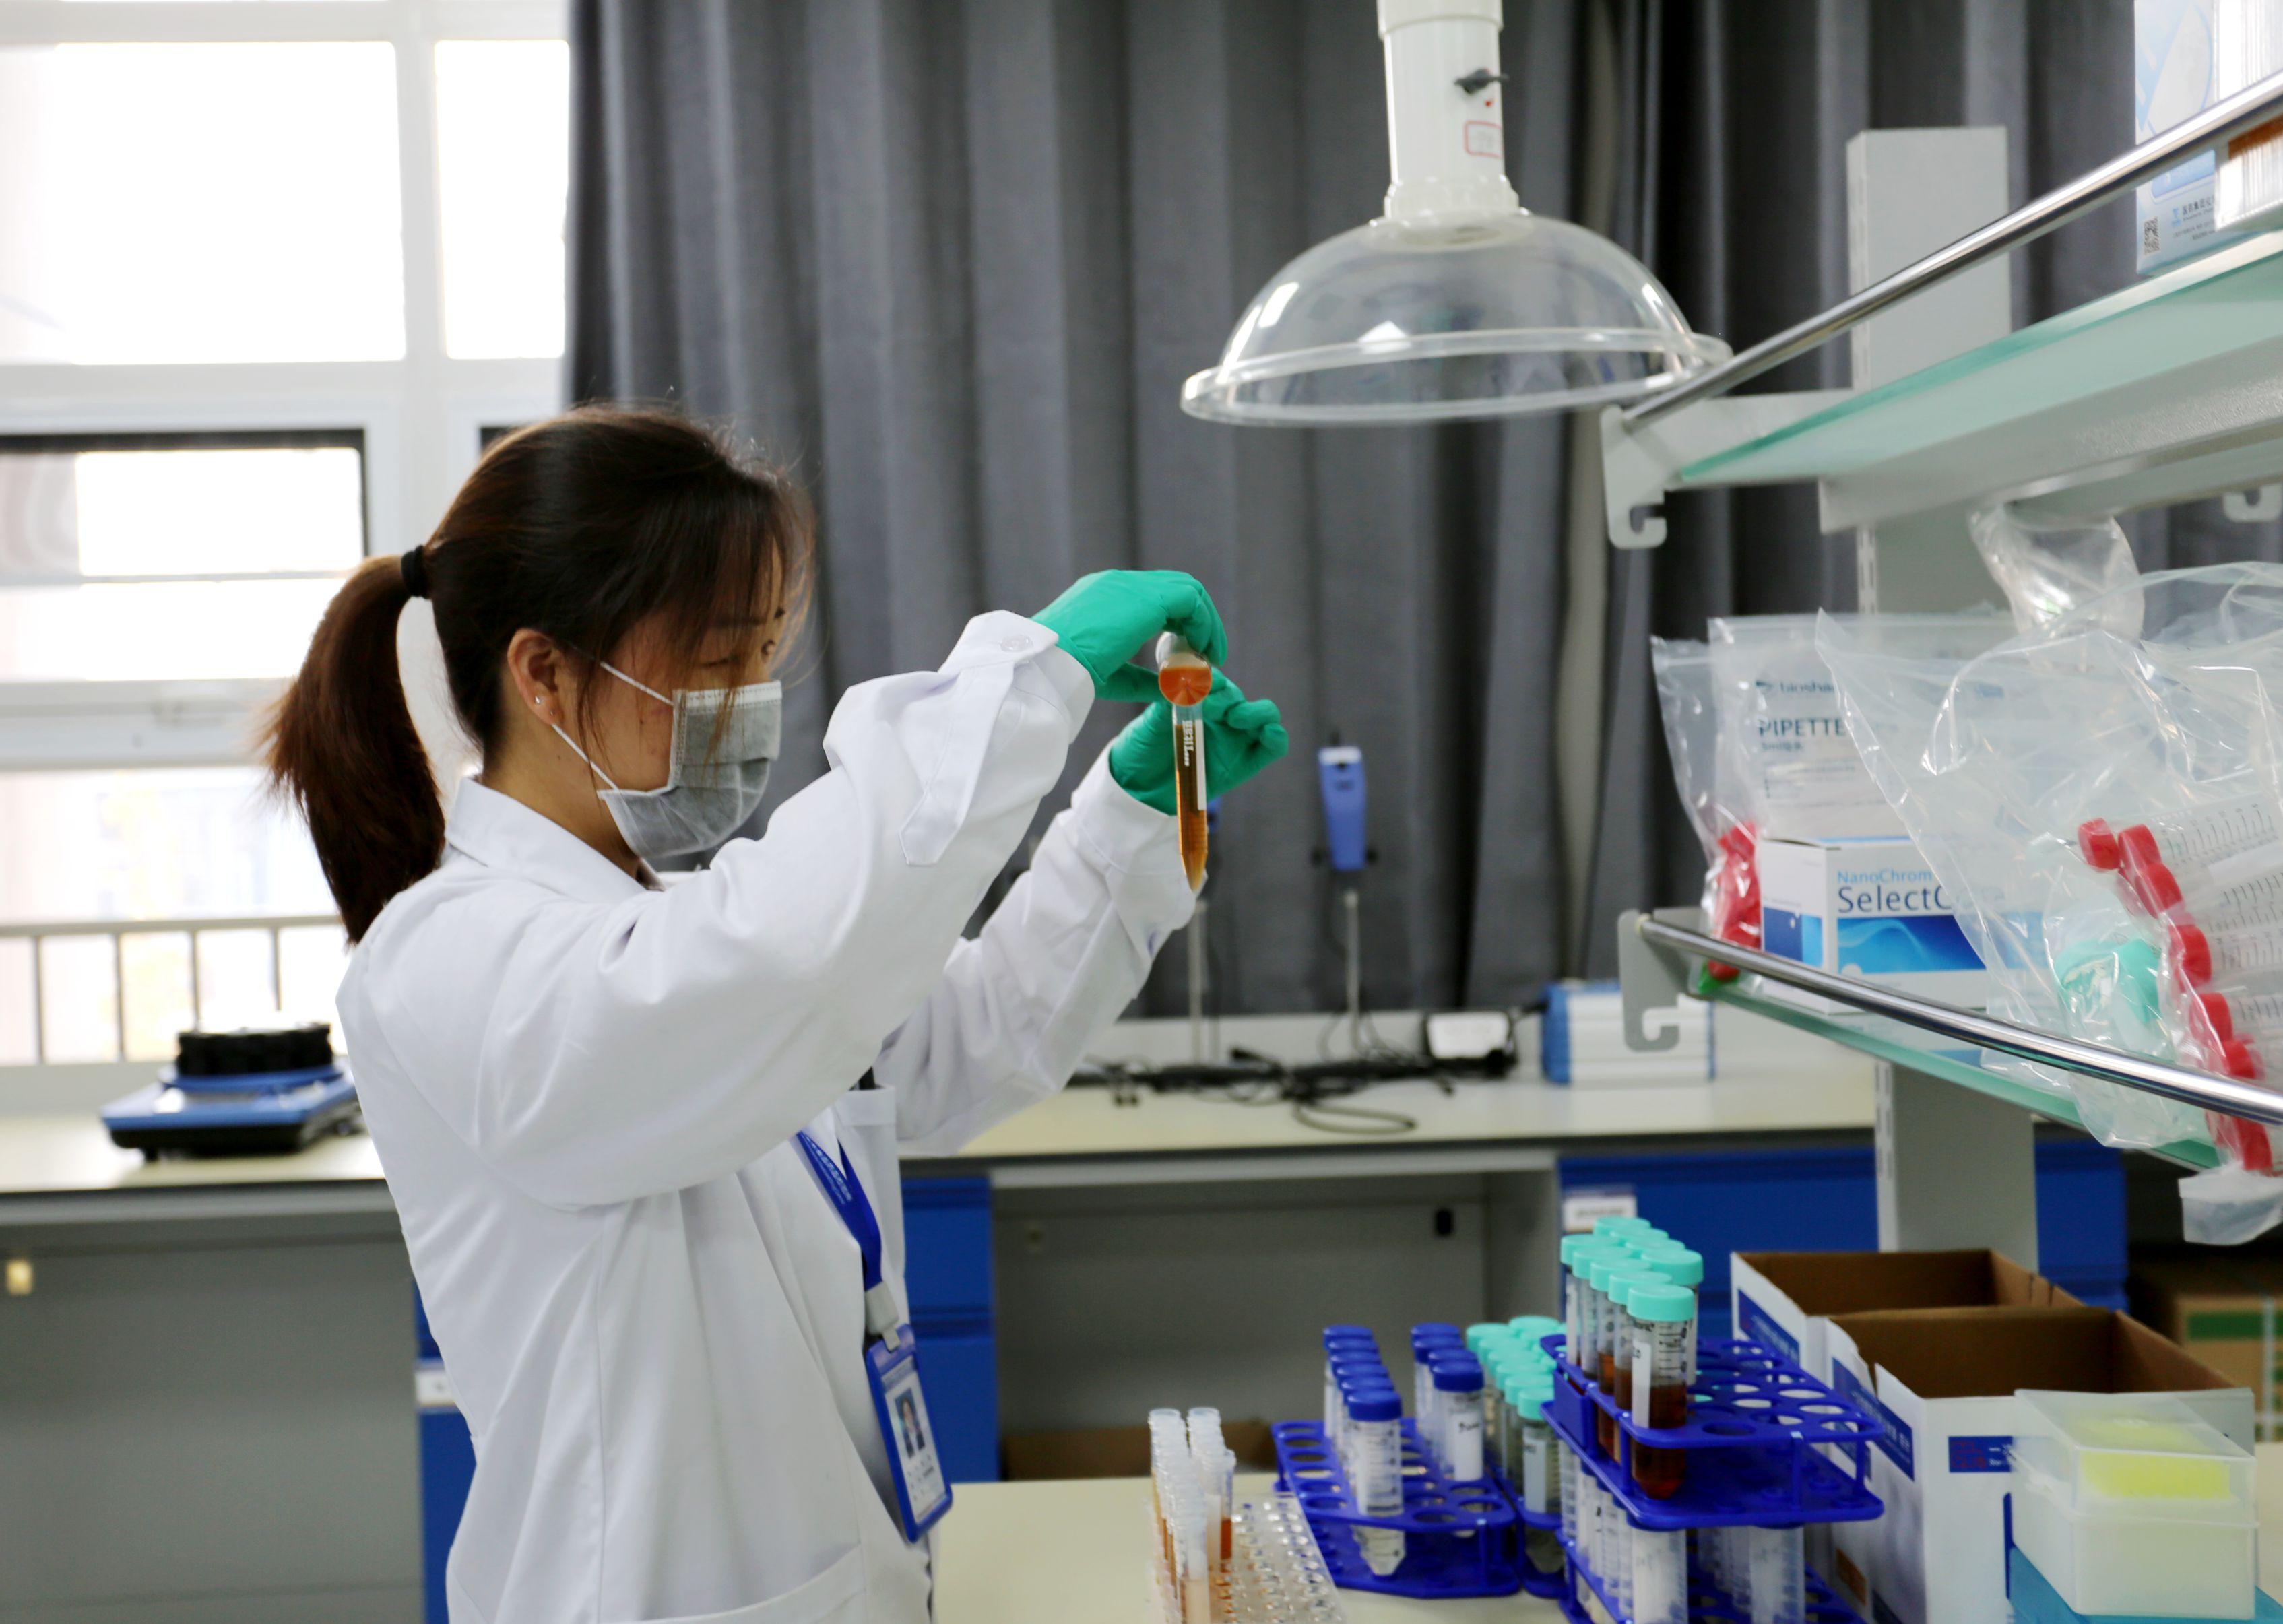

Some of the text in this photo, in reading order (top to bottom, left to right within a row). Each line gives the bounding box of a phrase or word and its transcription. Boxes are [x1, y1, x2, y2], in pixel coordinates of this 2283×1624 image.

[1758, 718, 1845, 736] PIPETTE
[1837, 867, 1933, 884] NanoChrom
[1838, 884, 1952, 913] SelectC
